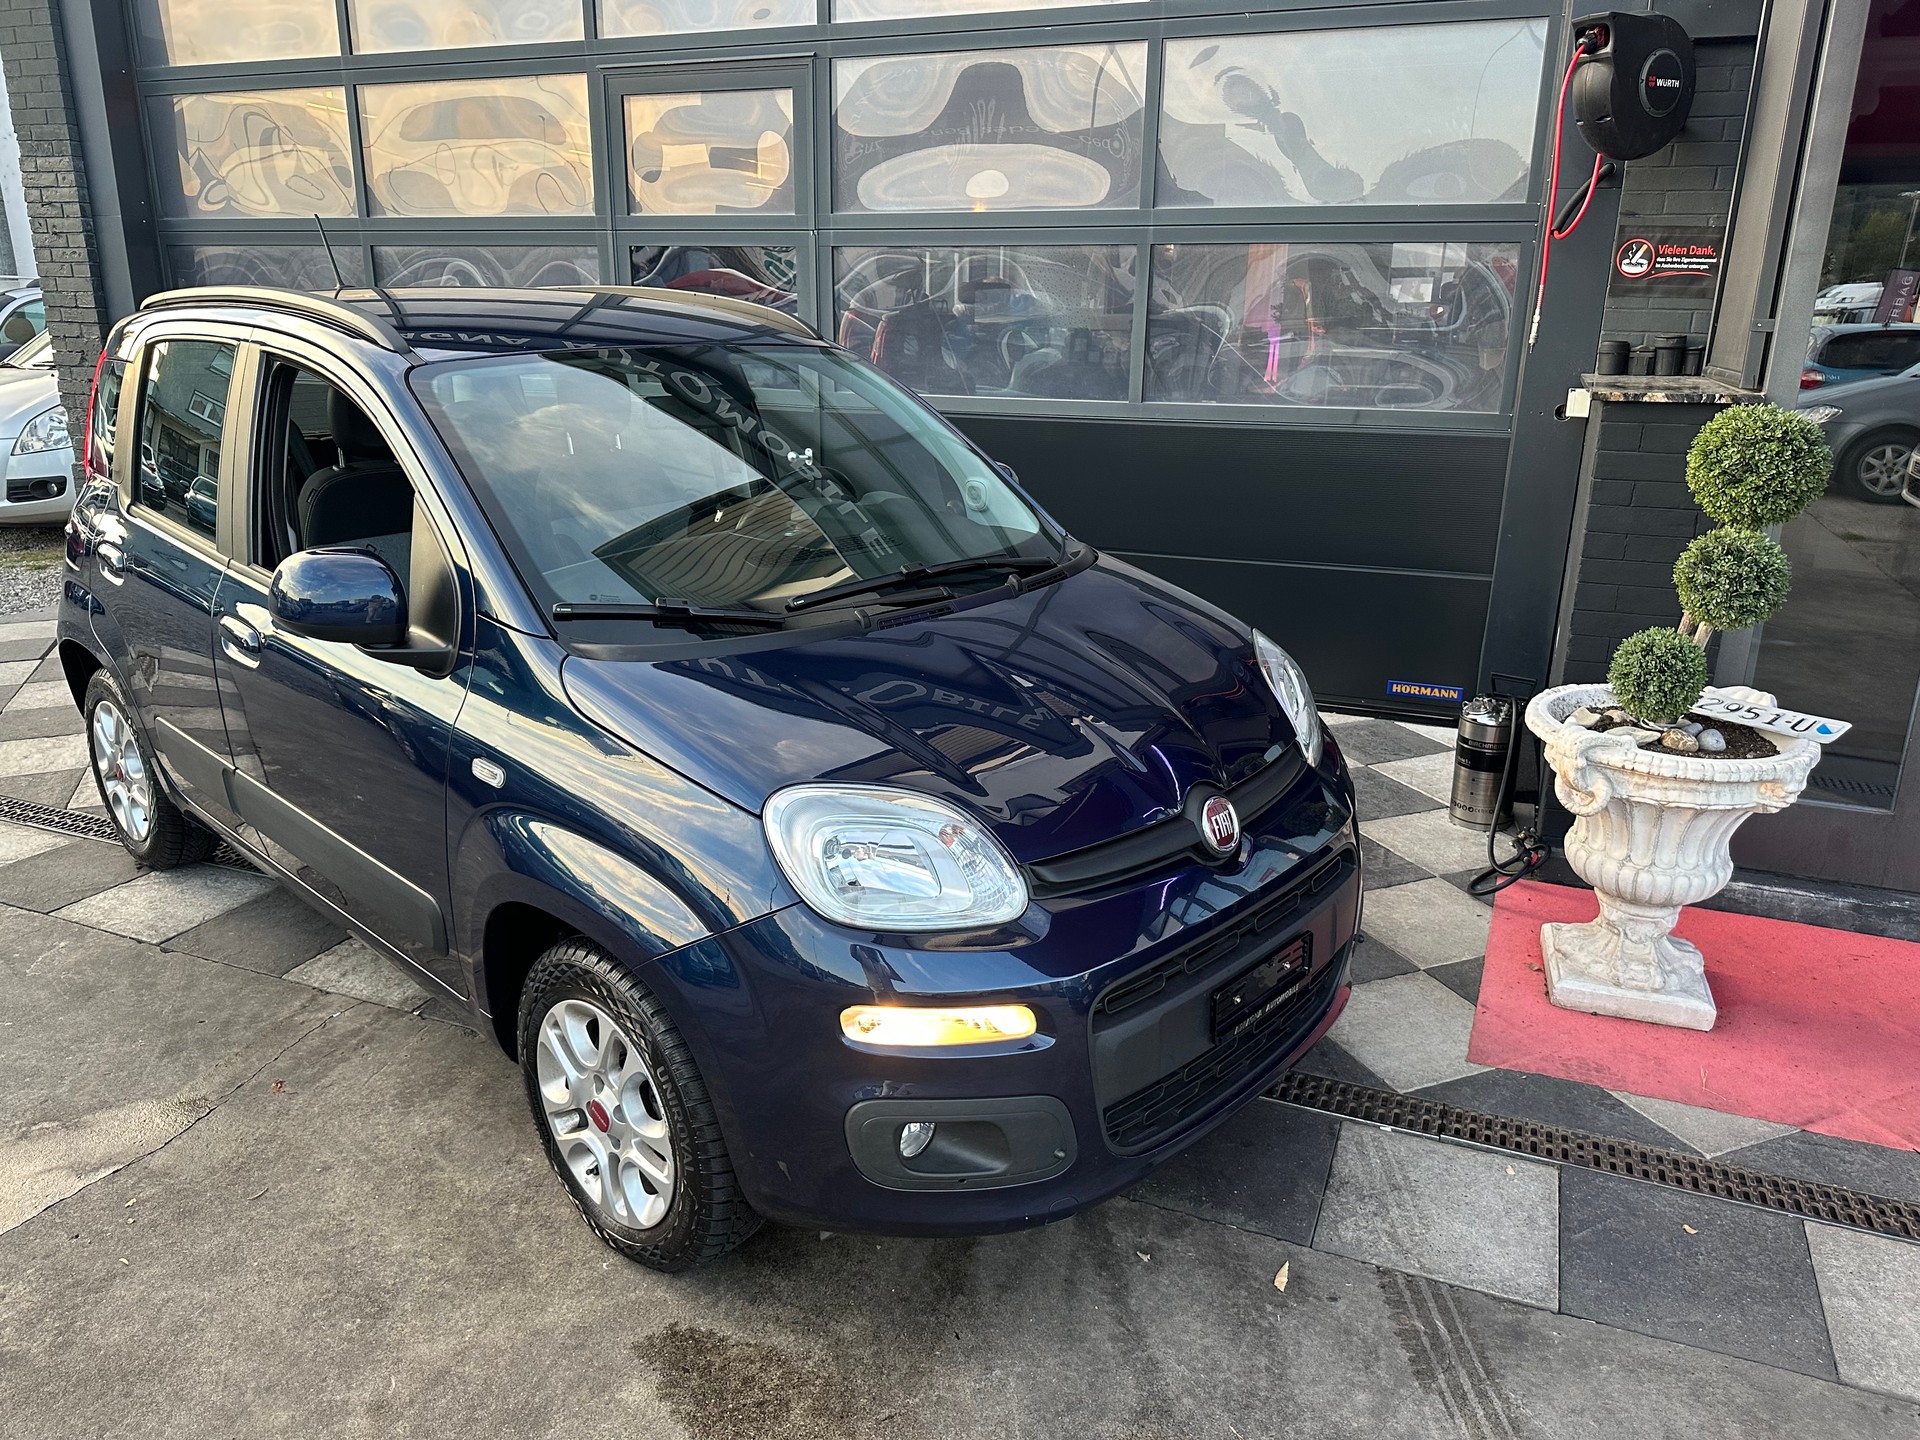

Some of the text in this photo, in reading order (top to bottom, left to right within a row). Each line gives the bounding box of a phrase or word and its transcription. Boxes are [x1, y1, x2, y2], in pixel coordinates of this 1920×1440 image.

[1658, 244, 1716, 257] Vielen Dank,
[1392, 683, 1458, 699] HÖRMANN
[1210, 809, 1234, 840] FIAT
[656, 1065, 695, 1176] UNIROYAL
